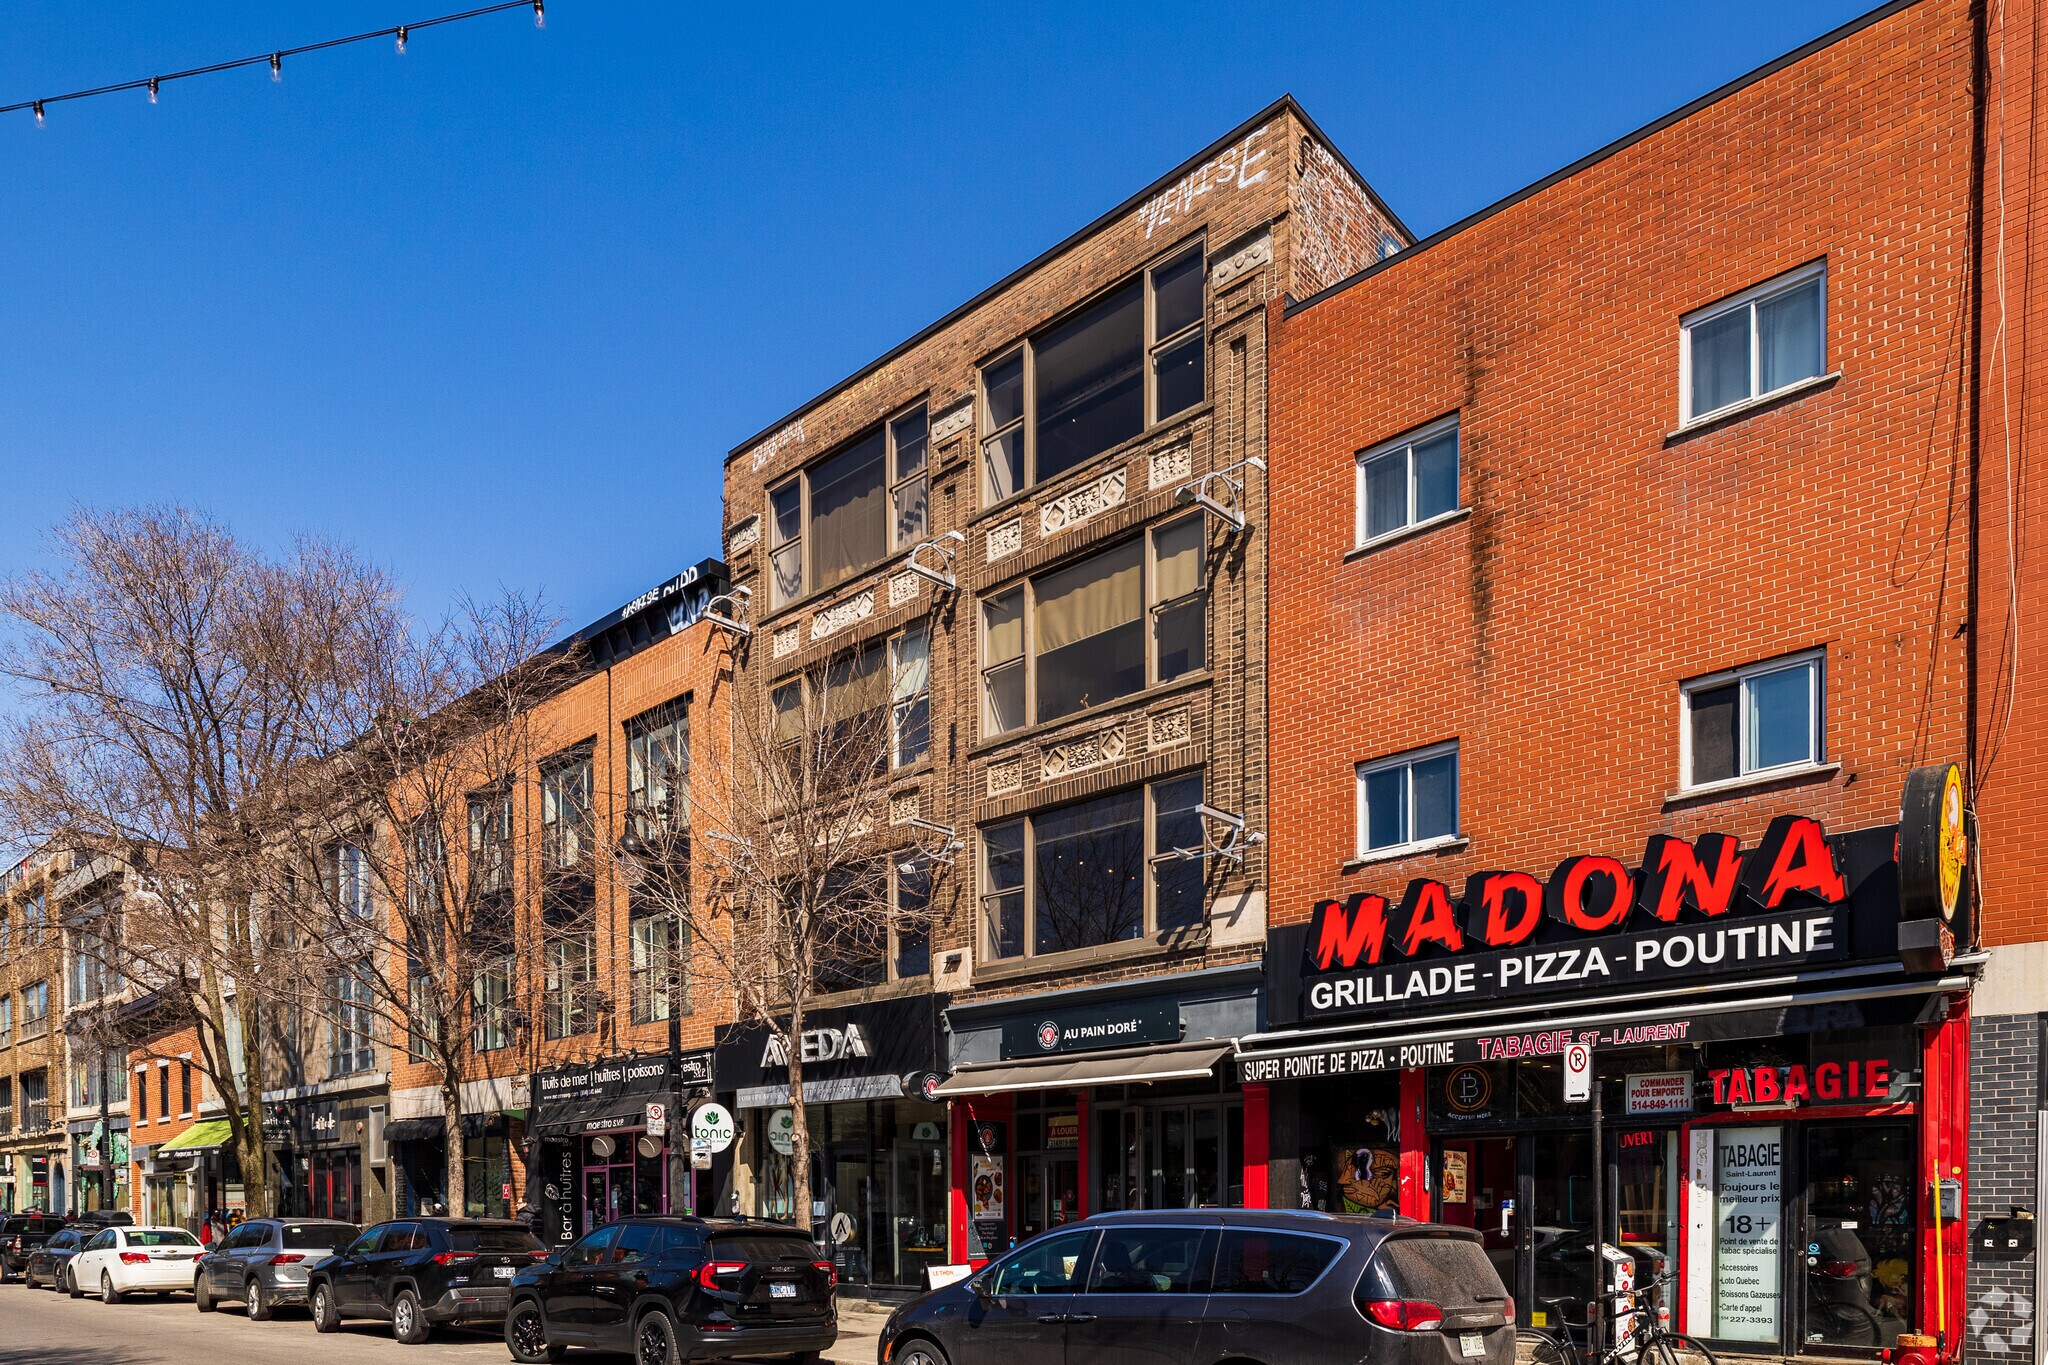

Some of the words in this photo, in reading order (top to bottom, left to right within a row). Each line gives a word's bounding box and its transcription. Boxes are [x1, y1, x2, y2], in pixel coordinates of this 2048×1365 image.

[1316, 817, 1846, 971] MADONA
[1310, 963, 1476, 1010] GRILLADE
[1500, 947, 1610, 988] PIZZA
[1635, 916, 1834, 972] POUTINE
[1063, 1028, 1078, 1040] AU
[1080, 1024, 1105, 1038] PAIN
[1107, 1019, 1137, 1035] DORÉ
[1478, 1029, 1573, 1060] TABAGIE
[1244, 1059, 1280, 1081] SUPER
[1284, 1055, 1325, 1077] POINTE
[1330, 1053, 1346, 1073] DE
[1350, 1049, 1385, 1071] PIZZA
[1400, 1042, 1454, 1067] POUTINE
[541, 1076, 559, 1090] fruits
[560, 1075, 571, 1087] de
[572, 1073, 588, 1087] mer
[594, 1068, 621, 1084] huîtres
[627, 1063, 664, 1080] poissons
[1707, 1059, 1890, 1105] TABAGIE
[1640, 1077, 1685, 1088] COMMANDER
[1631, 1088, 1650, 1098] POUR
[1651, 1087, 1684, 1097] EMPORTE
[1631, 1098, 1689, 1110] 514-849-1111
[586, 1119, 612, 1130] maestro
[694, 1125, 731, 1139] tonic
[1057, 1126, 1078, 1135] LOUER
[1720, 1143, 1780, 1168] TABAGIE
[560, 1151, 572, 1201] huîtres
[1725, 1170, 1777, 1178] Saint-Laurent
[1720, 1183, 1767, 1193] Toujours
[1769, 1182, 1780, 1191] le
[1720, 1194, 1758, 1204] meilleur
[1760, 1194, 1780, 1204] prix
[558, 1203, 572, 1212] à
[560, 1217, 573, 1240] Bar
[1720, 1237, 1737, 1245] Point
[1738, 1237, 1748, 1245] de
[1769, 1237, 1779, 1245] de
[1721, 1247, 1741, 1255] tabac
[1735, 1276, 1760, 1286] Quebec
[1750, 1290, 1781, 1299] Gazeuses
[1739, 1303, 1763, 1313] d'appel
[1730, 1316, 1773, 1324] 227-3393
